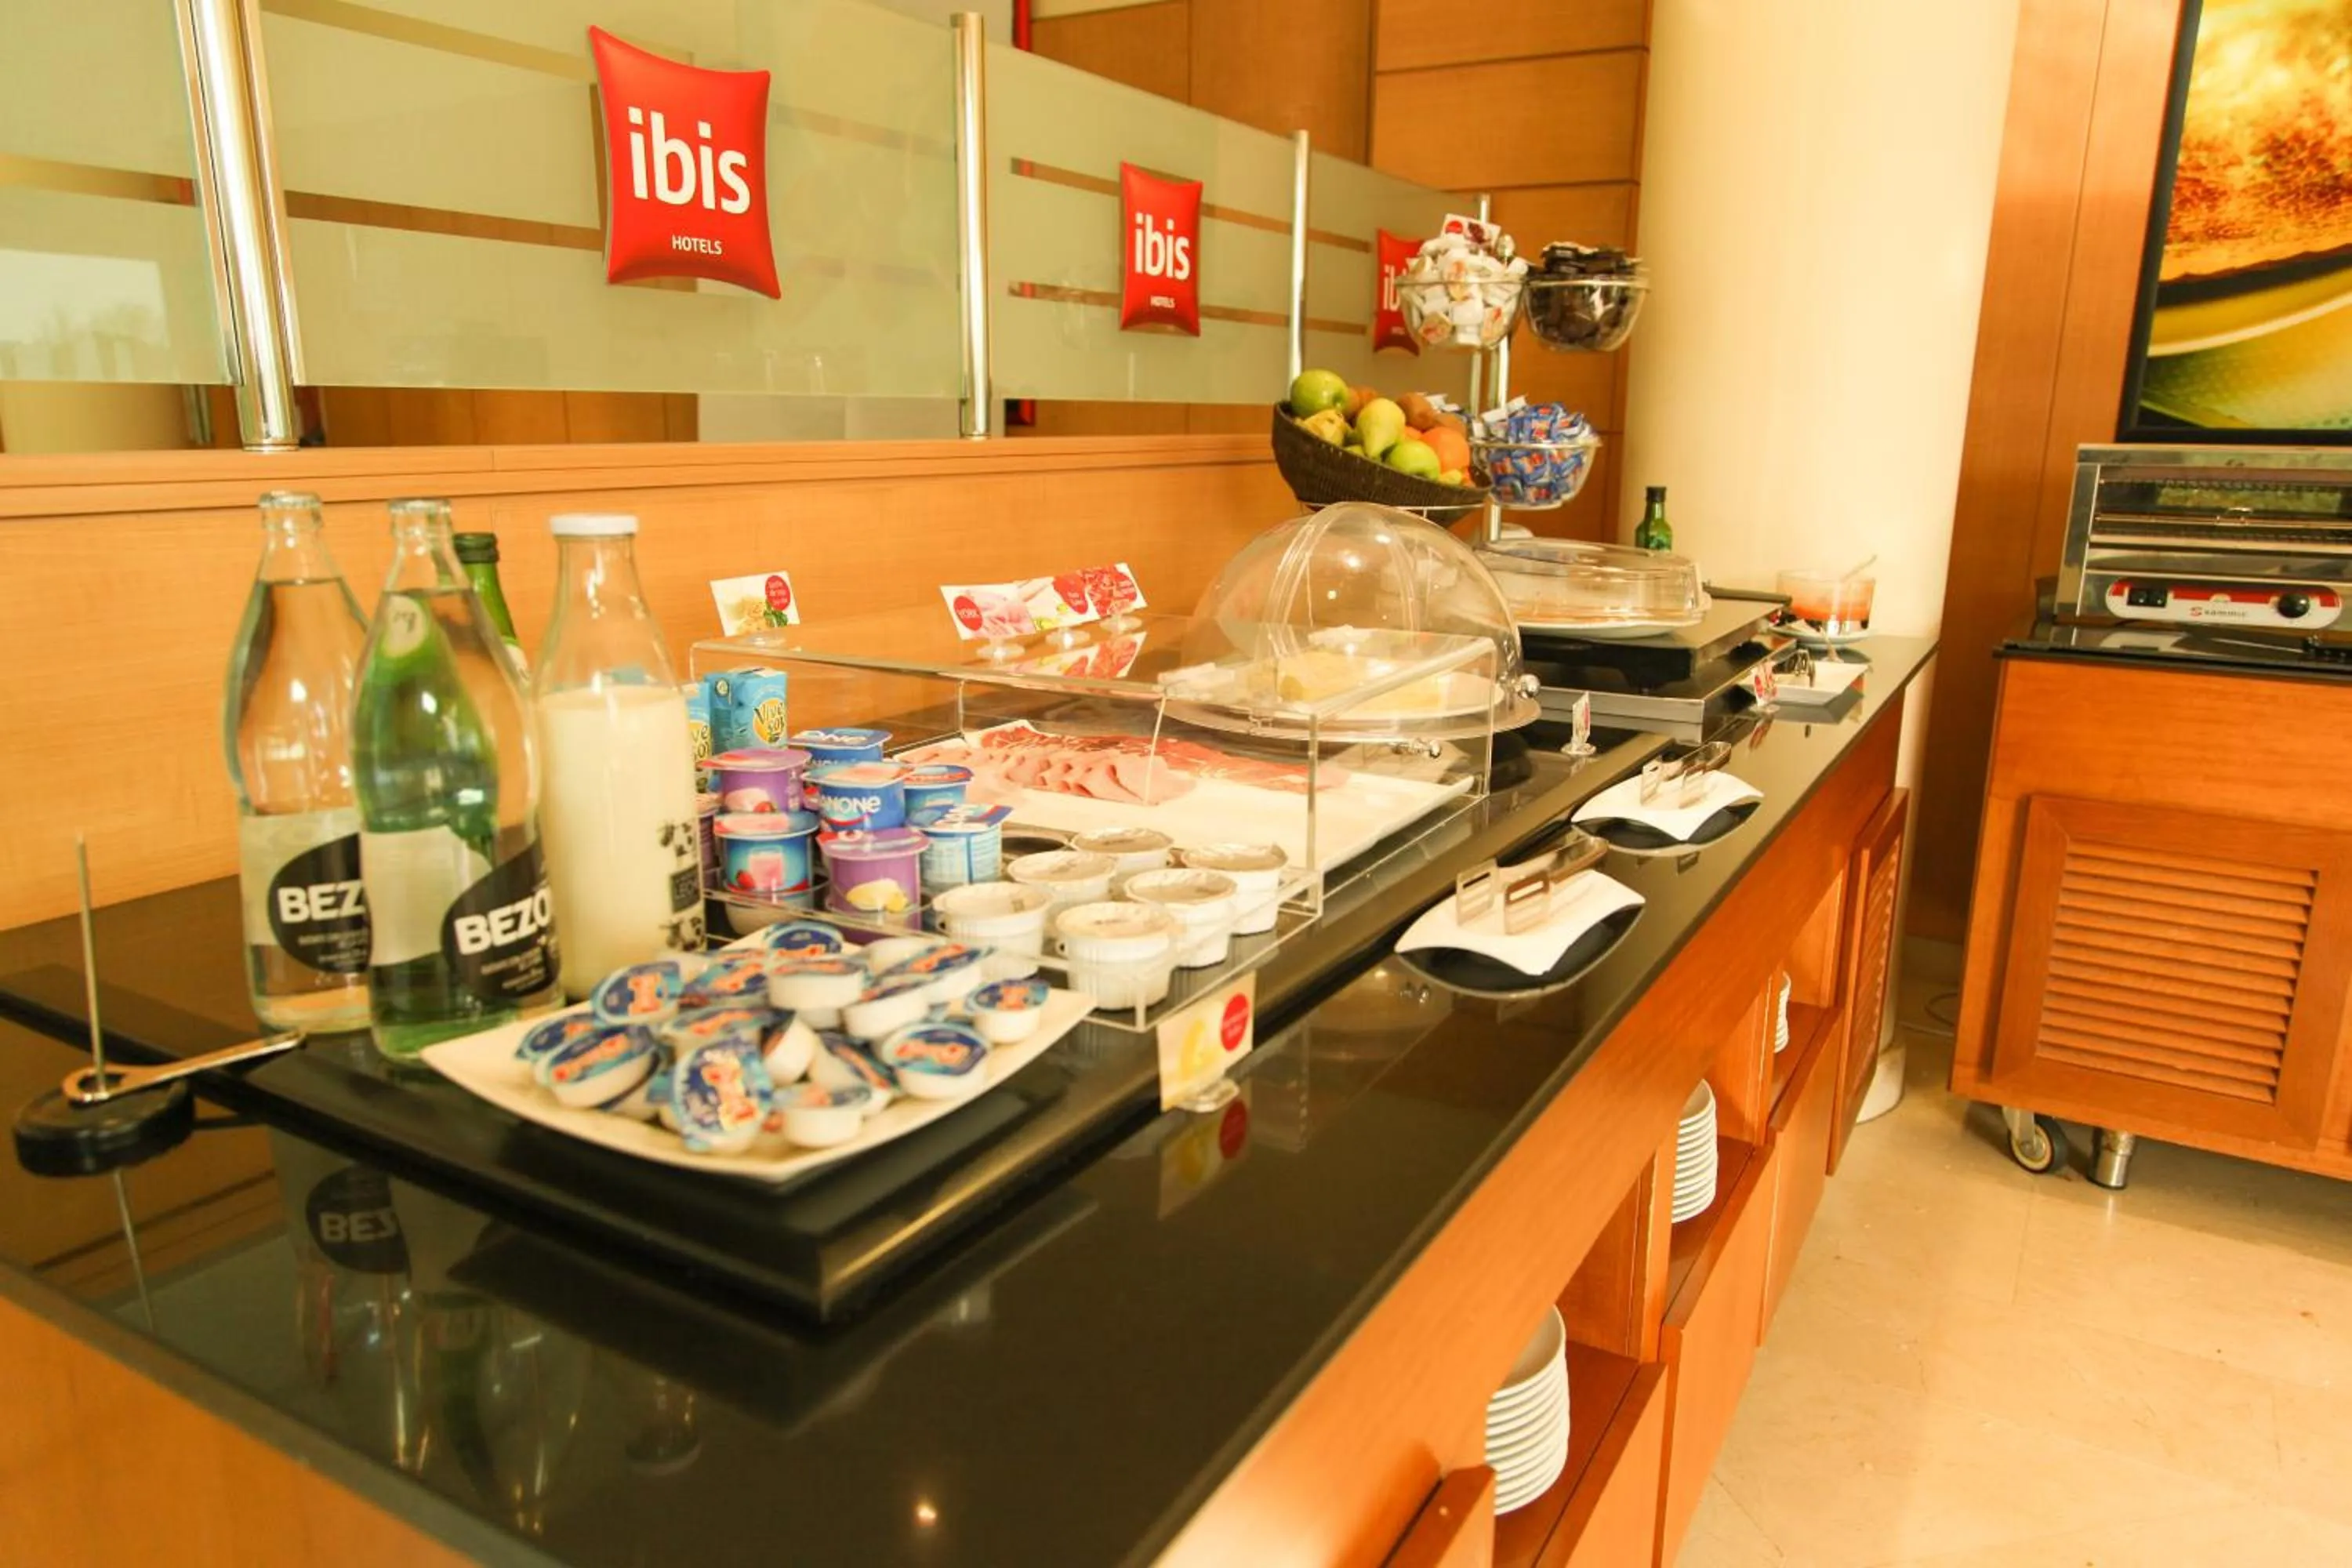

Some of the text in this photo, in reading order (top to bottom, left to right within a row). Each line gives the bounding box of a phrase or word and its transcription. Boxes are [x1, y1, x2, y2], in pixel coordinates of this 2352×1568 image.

[628, 106, 750, 214] ibis
[672, 234, 723, 255] HOTELS
[1134, 212, 1191, 281] ibis
[278, 879, 367, 924] BEZ
[454, 887, 553, 956] BEZO
